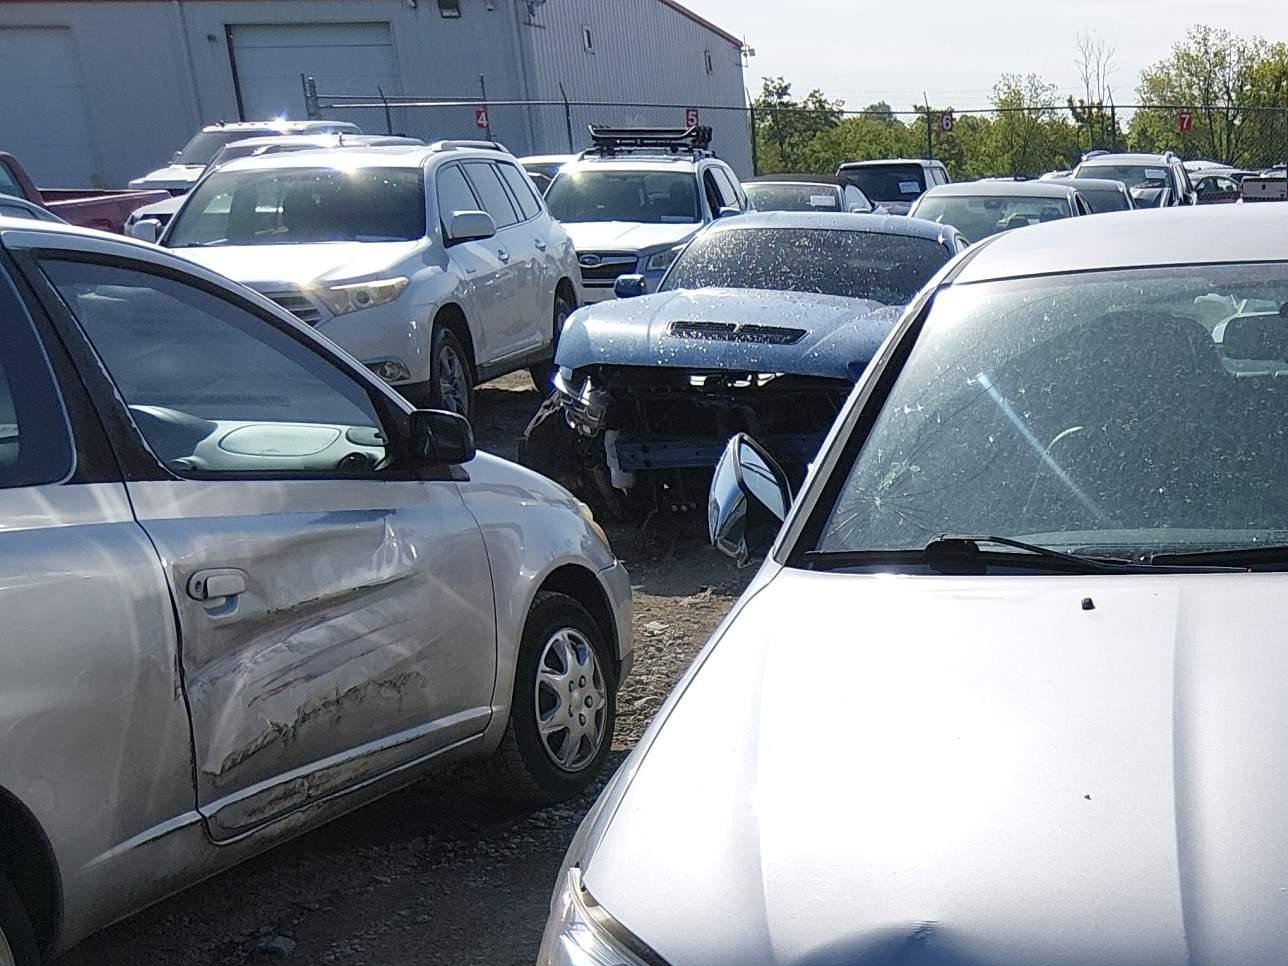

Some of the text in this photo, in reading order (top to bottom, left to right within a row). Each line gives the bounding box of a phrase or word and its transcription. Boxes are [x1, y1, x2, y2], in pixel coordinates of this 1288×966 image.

[478, 111, 488, 127] 4
[687, 110, 697, 126] 5
[942, 115, 952, 130] 6
[1180, 114, 1190, 129] 7
